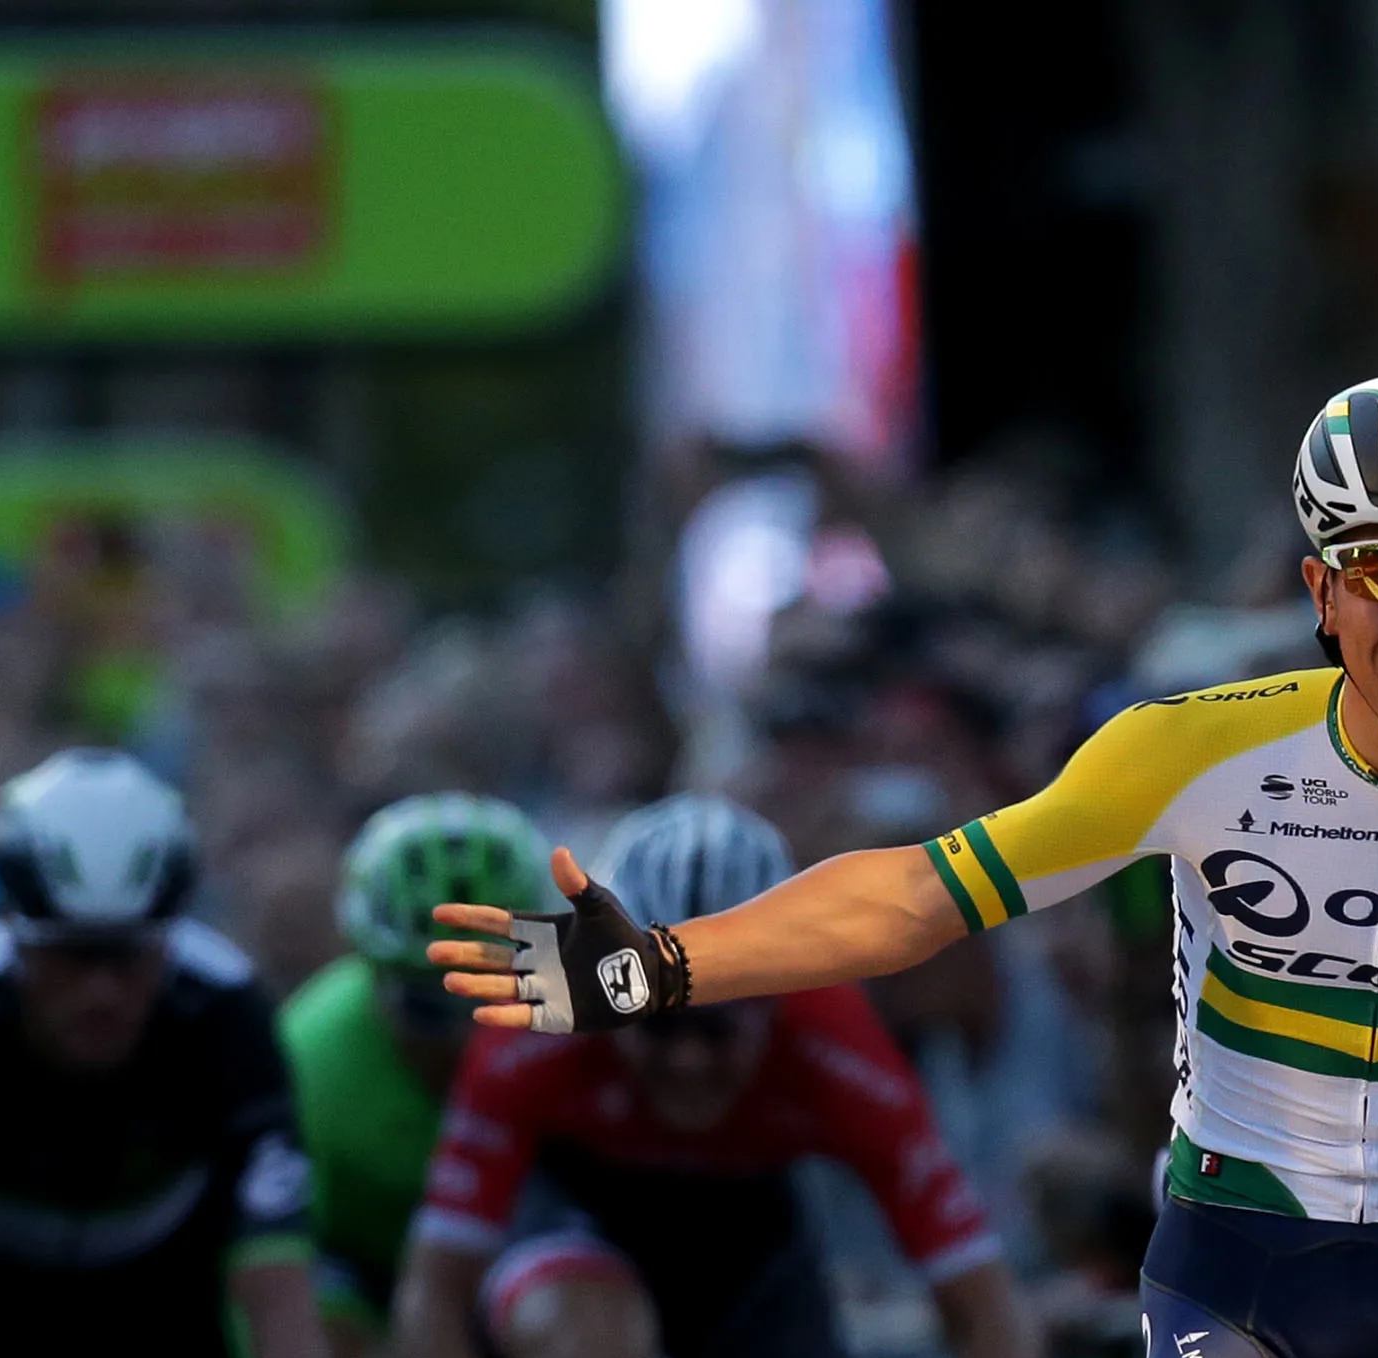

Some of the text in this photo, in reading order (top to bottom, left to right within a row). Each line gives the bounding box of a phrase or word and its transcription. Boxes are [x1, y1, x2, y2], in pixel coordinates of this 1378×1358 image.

[1197, 681, 1300, 703] ORICA
[1301, 777, 1327, 788] UCI
[1302, 787, 1349, 800] WORLD
[1302, 795, 1338, 807] TOUR
